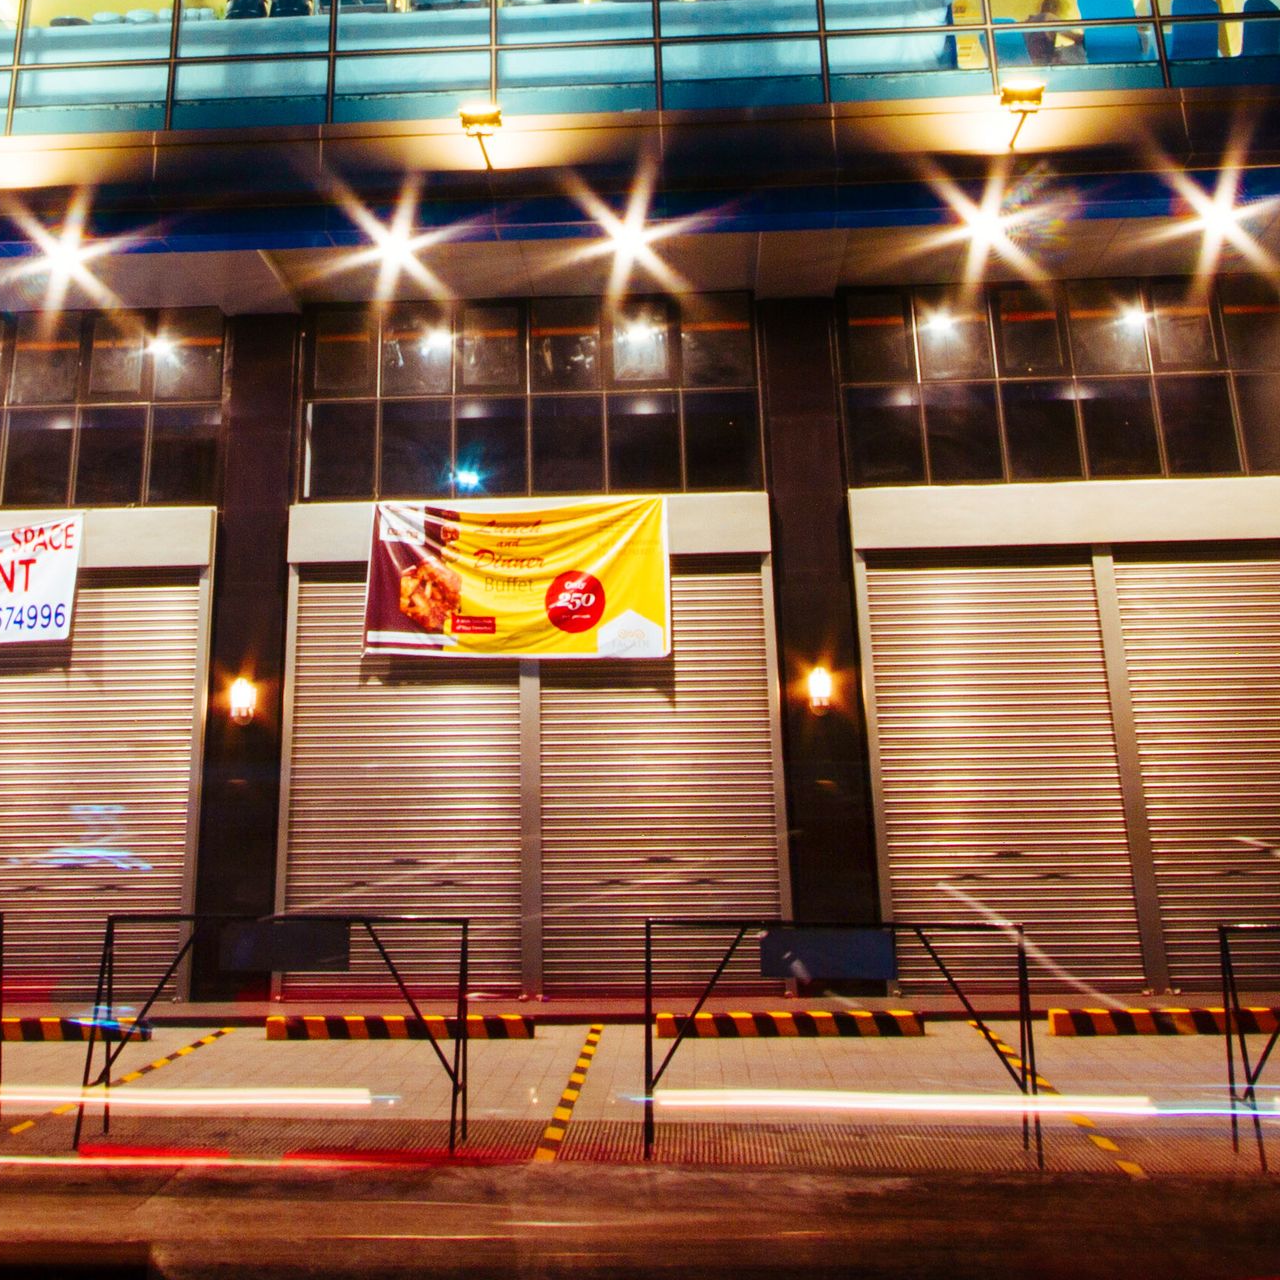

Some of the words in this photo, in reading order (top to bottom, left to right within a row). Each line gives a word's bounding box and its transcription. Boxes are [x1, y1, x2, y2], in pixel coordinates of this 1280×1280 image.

[11, 523, 75, 554] SPACE
[496, 538, 521, 549] and
[473, 549, 545, 570] Dinner
[484, 576, 535, 593] Buffet
[552, 591, 596, 610] 250
